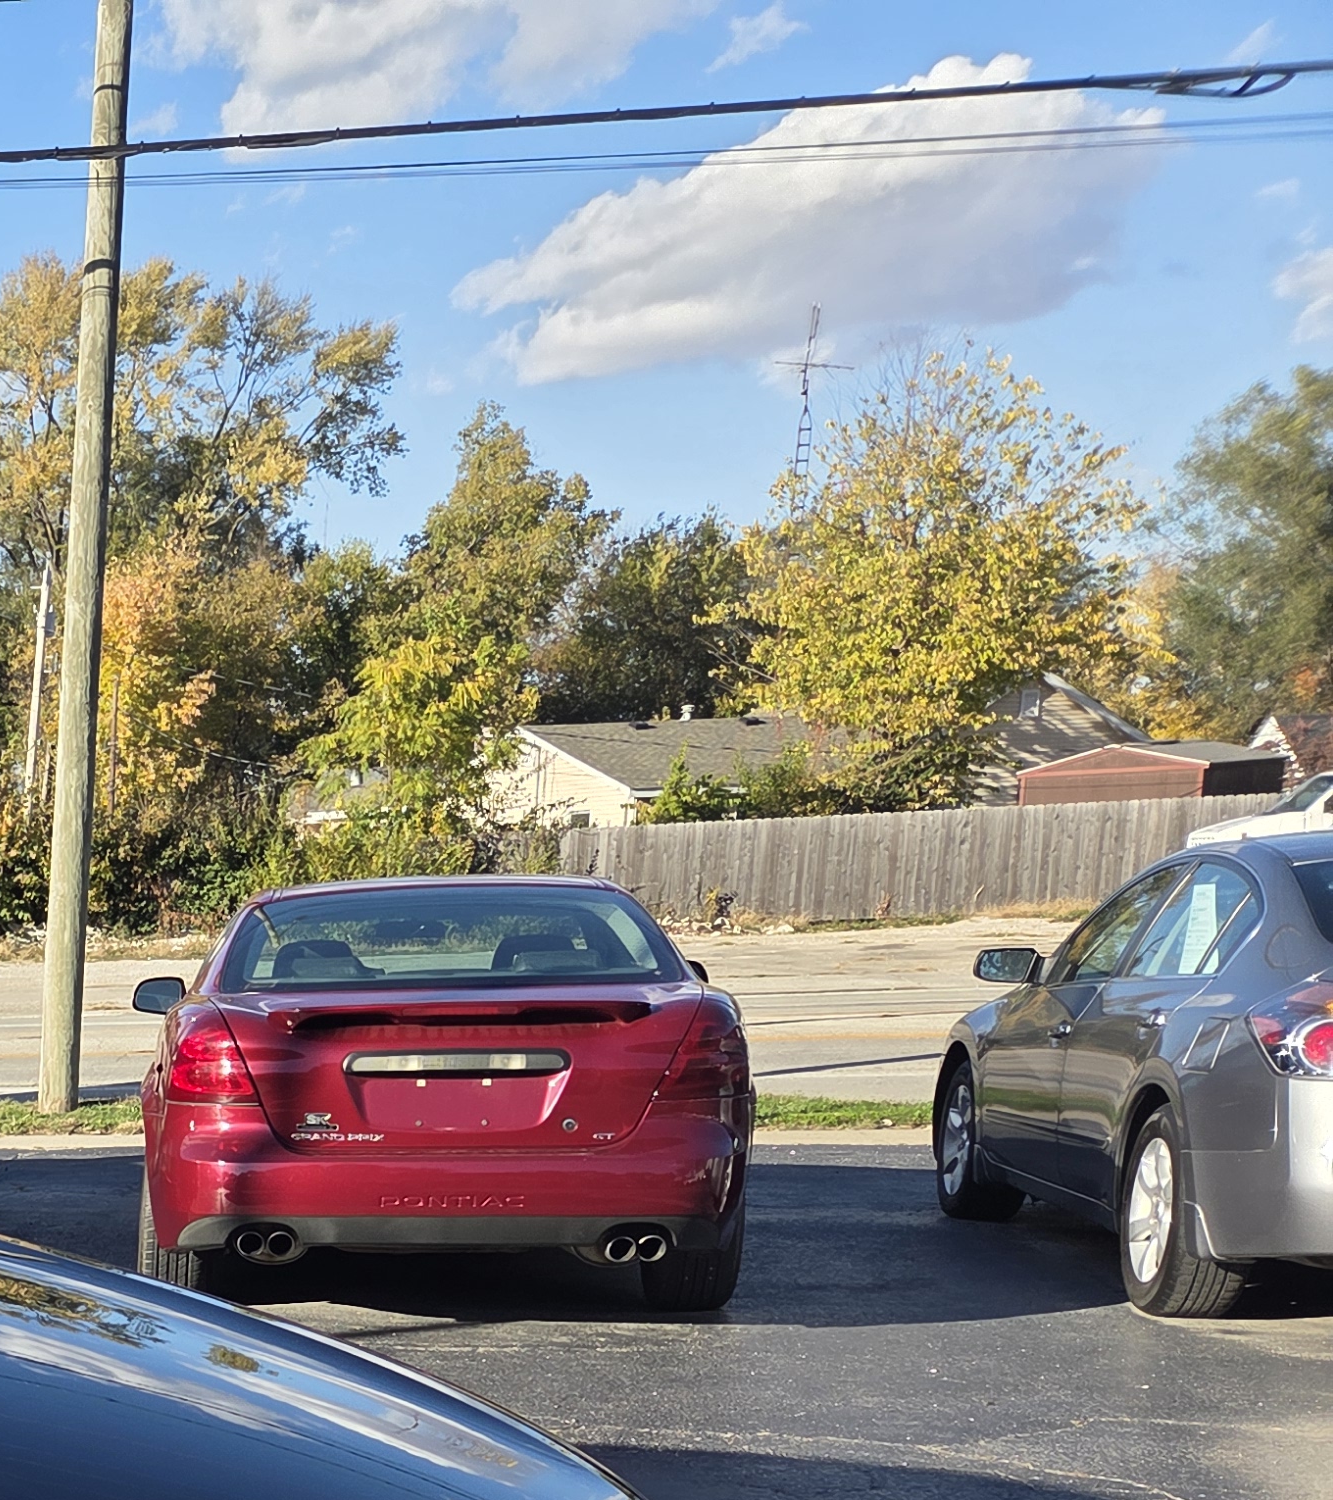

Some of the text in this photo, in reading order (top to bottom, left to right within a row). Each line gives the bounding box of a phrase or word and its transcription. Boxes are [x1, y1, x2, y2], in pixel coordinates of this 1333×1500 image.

[291, 1132, 385, 1142] GRAND PRIX
[592, 1132, 616, 1140] GT
[380, 1195, 525, 1208] PONTIAC
